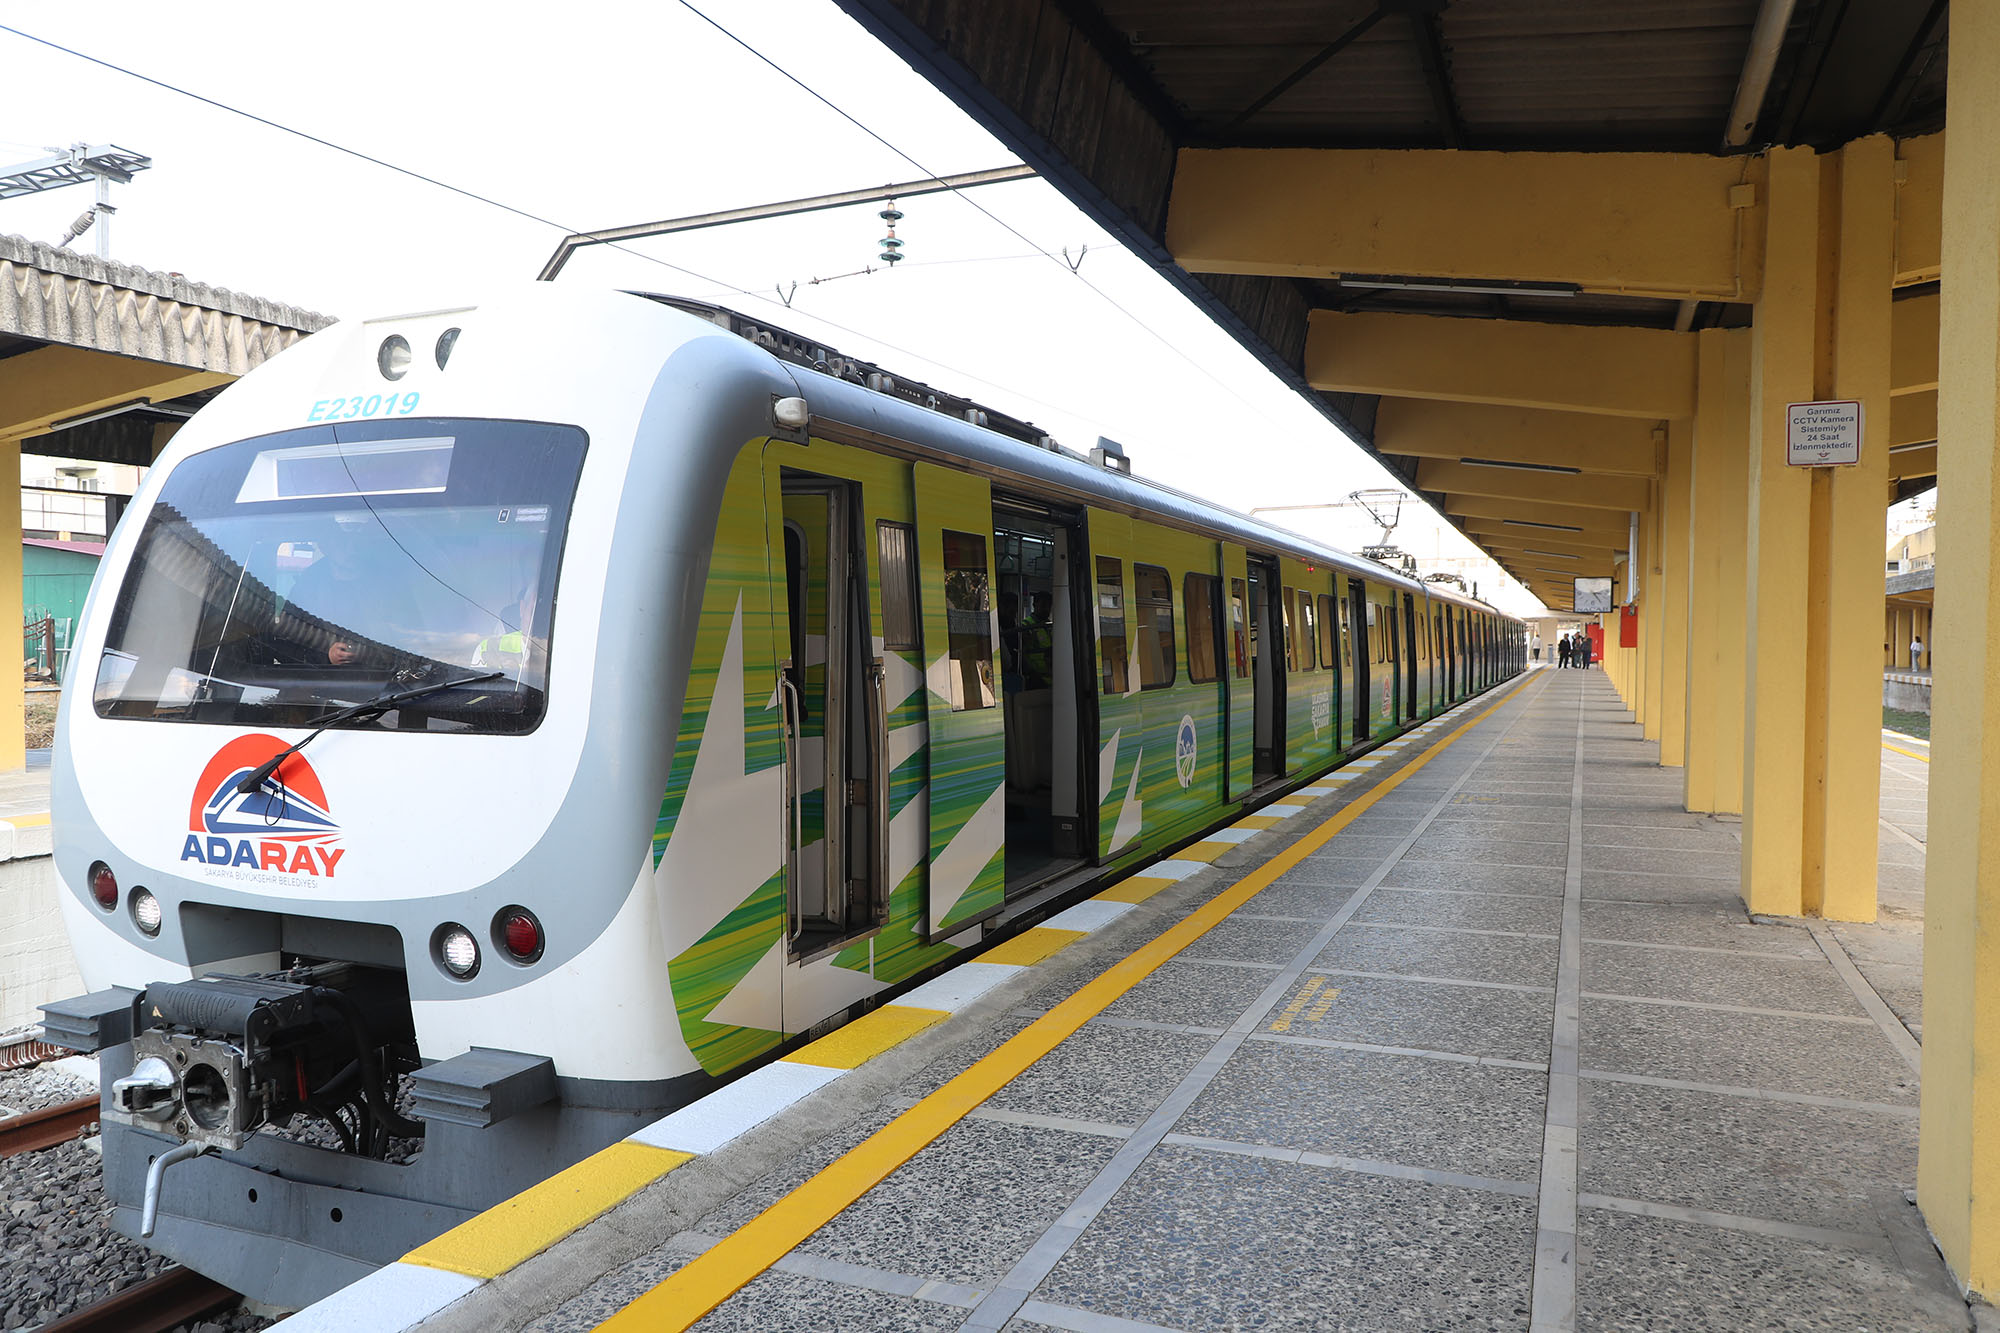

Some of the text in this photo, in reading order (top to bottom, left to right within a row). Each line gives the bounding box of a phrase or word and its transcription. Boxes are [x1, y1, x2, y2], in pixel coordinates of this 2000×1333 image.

[307, 391, 420, 422] E23019
[1807, 408, 1841, 416] Garımız
[1793, 416, 1854, 425] CCTV Kamera
[1801, 425, 1846, 433] Sistemiyle
[1793, 442, 1854, 451] İzlenmektedir.
[180, 834, 346, 878] ADARAY
[204, 867, 234, 880] SAKARYA
